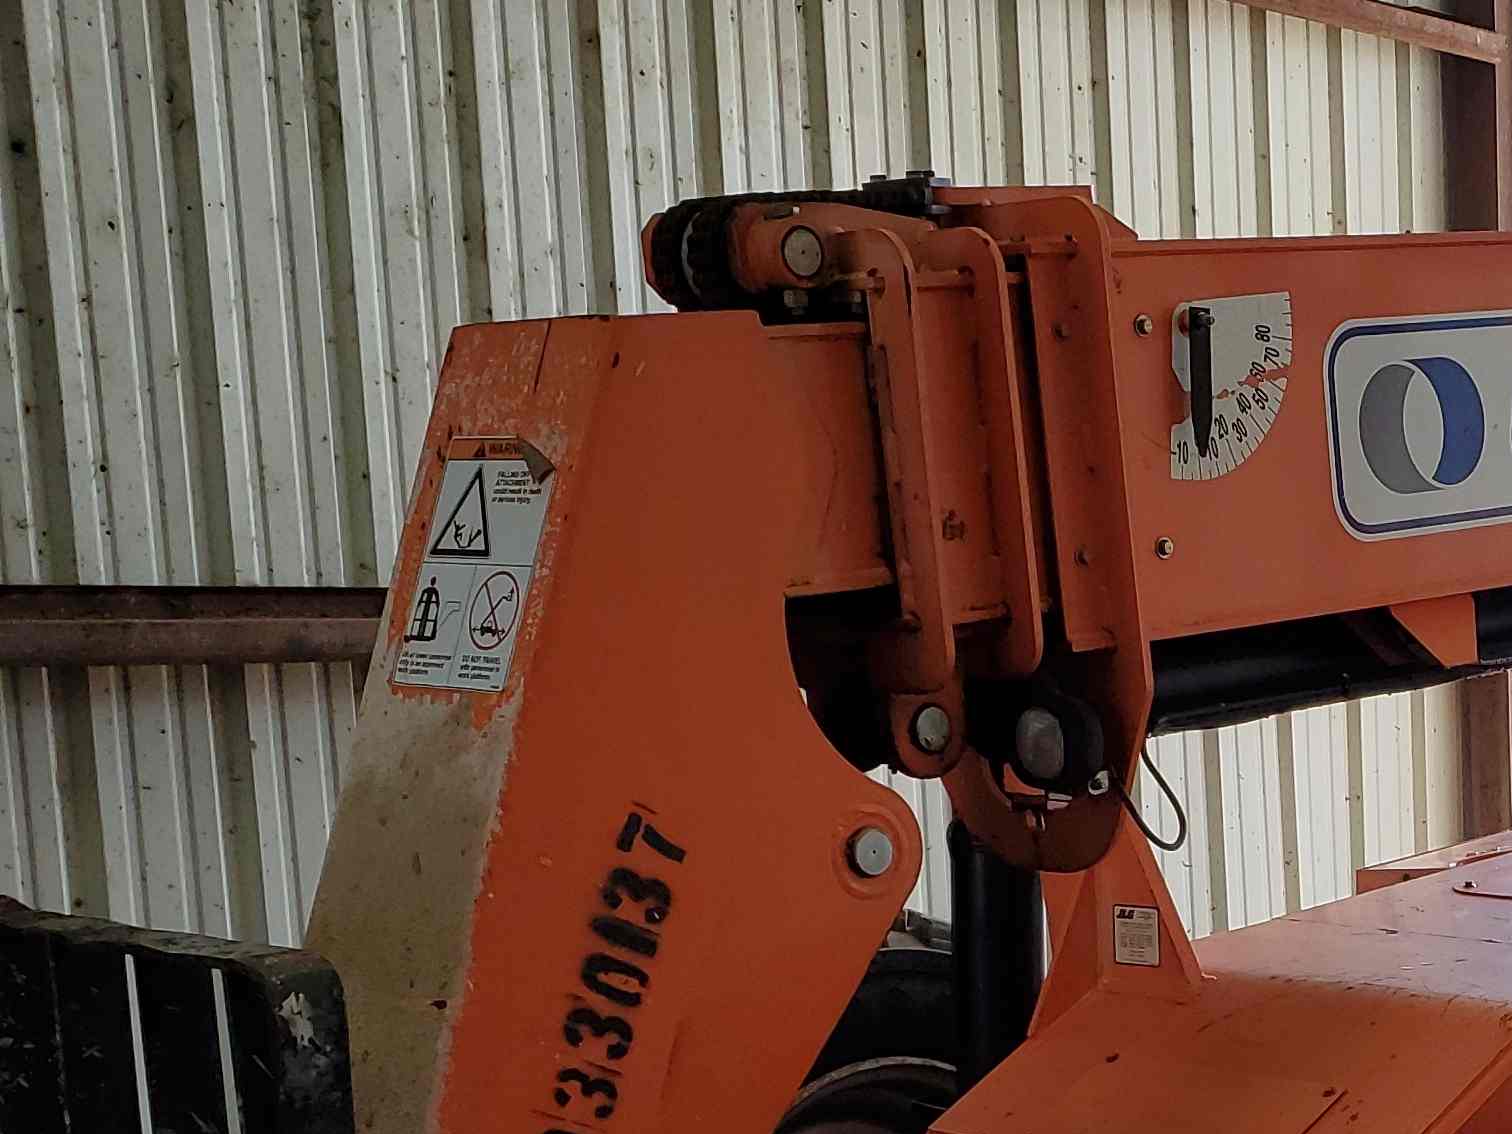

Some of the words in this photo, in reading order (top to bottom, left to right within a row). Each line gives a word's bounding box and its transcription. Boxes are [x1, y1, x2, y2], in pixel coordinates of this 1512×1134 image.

[1255, 324, 1271, 342] 80
[1264, 346, 1280, 368] 70
[1236, 392, 1252, 415] 40
[1252, 388, 1269, 410] 50
[1214, 413, 1229, 440] 20
[1231, 417, 1248, 442] 30
